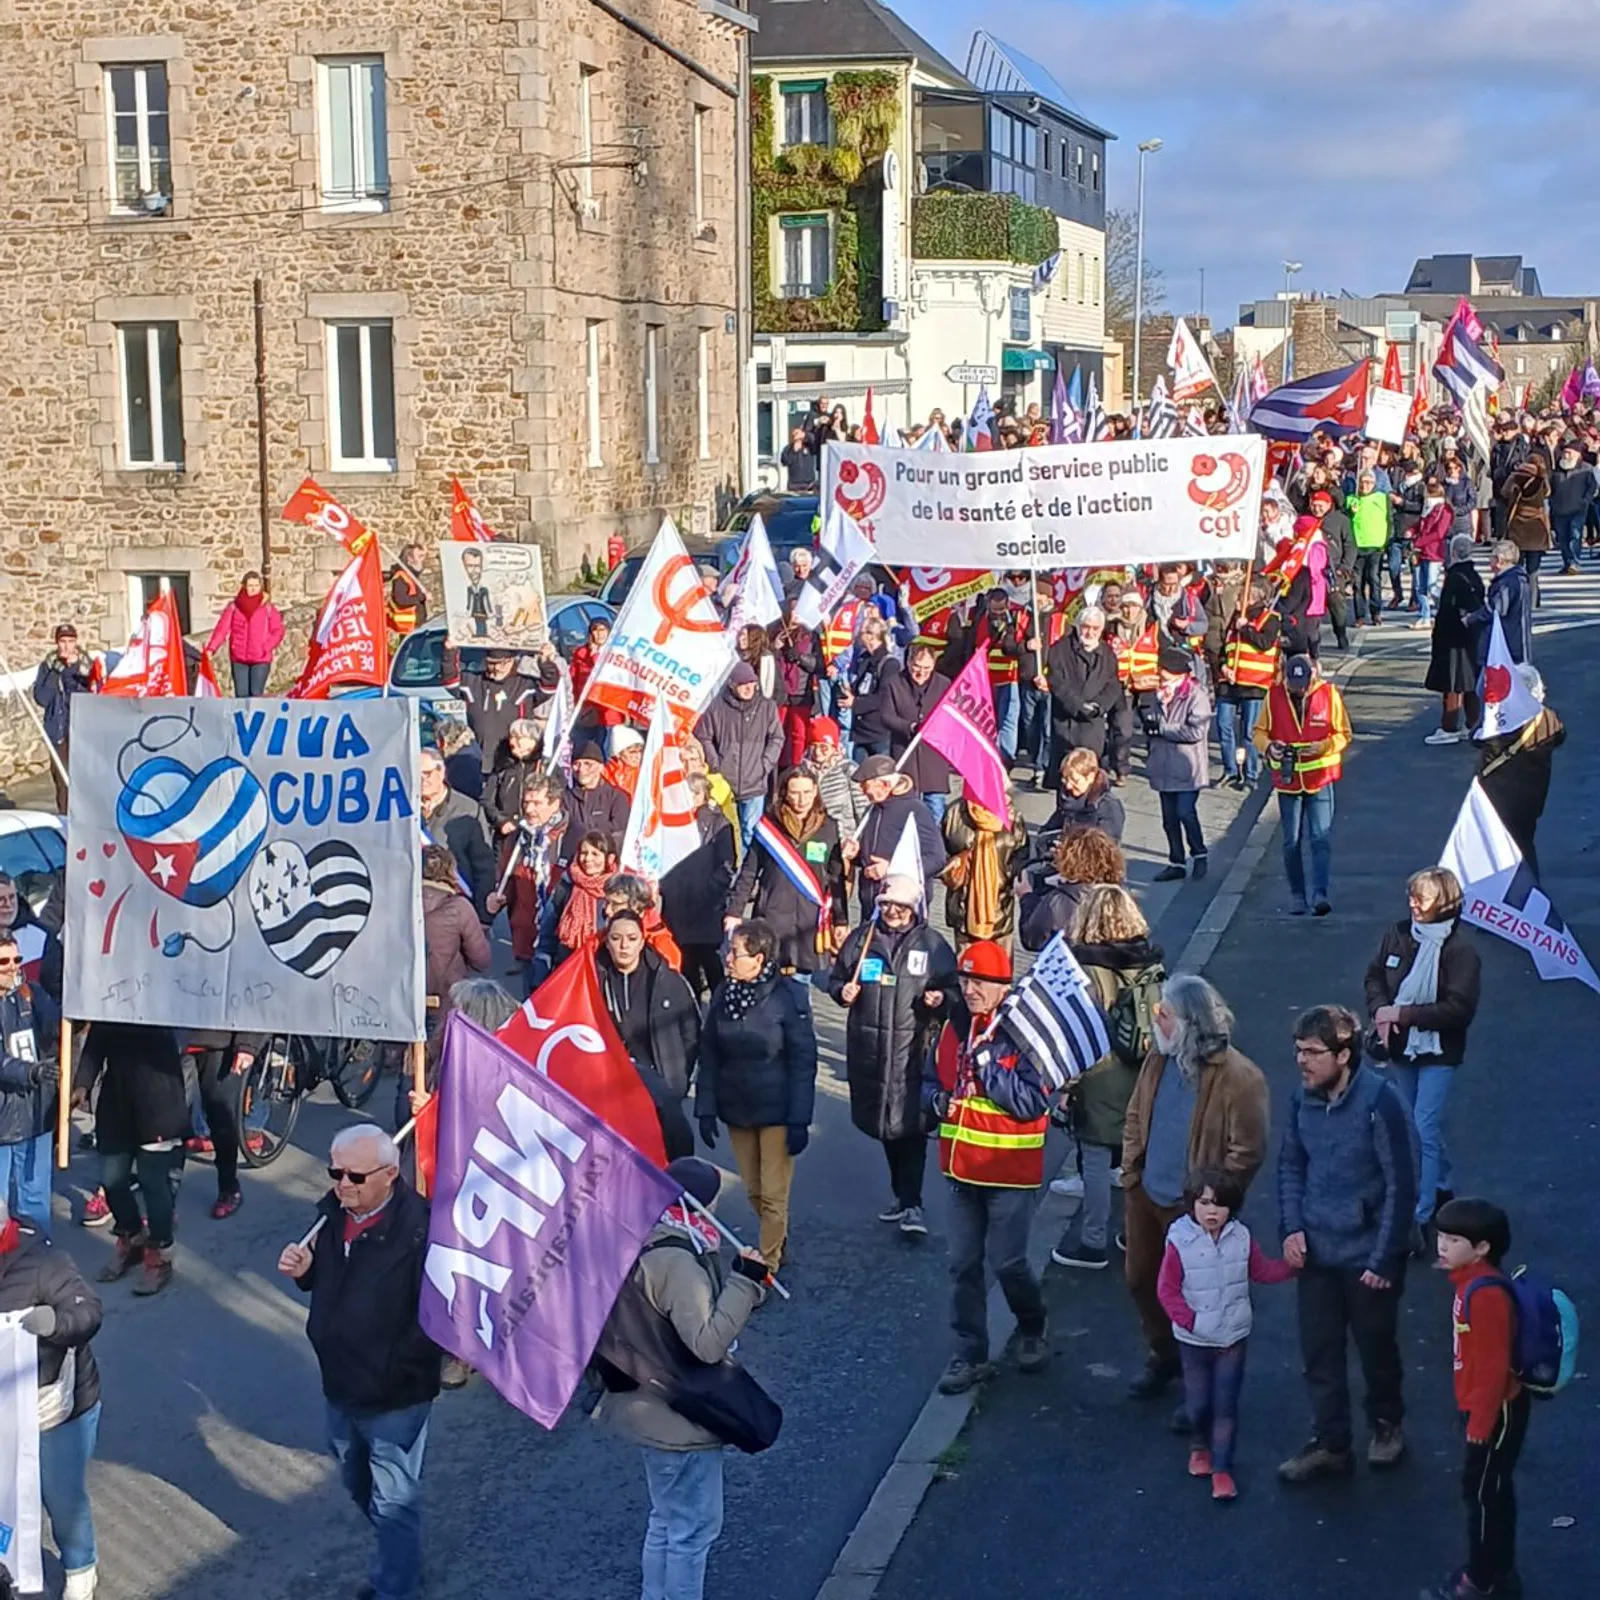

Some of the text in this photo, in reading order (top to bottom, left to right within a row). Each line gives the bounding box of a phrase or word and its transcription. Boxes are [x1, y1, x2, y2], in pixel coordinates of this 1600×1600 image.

[895, 452, 1169, 491] Pour un grand service public
[912, 493, 1153, 521] de la santé et de l'action
[1199, 511, 1240, 538] cgt
[996, 535, 1067, 557] sociale
[629, 638, 703, 686] France
[268, 767, 415, 826] CUBA
